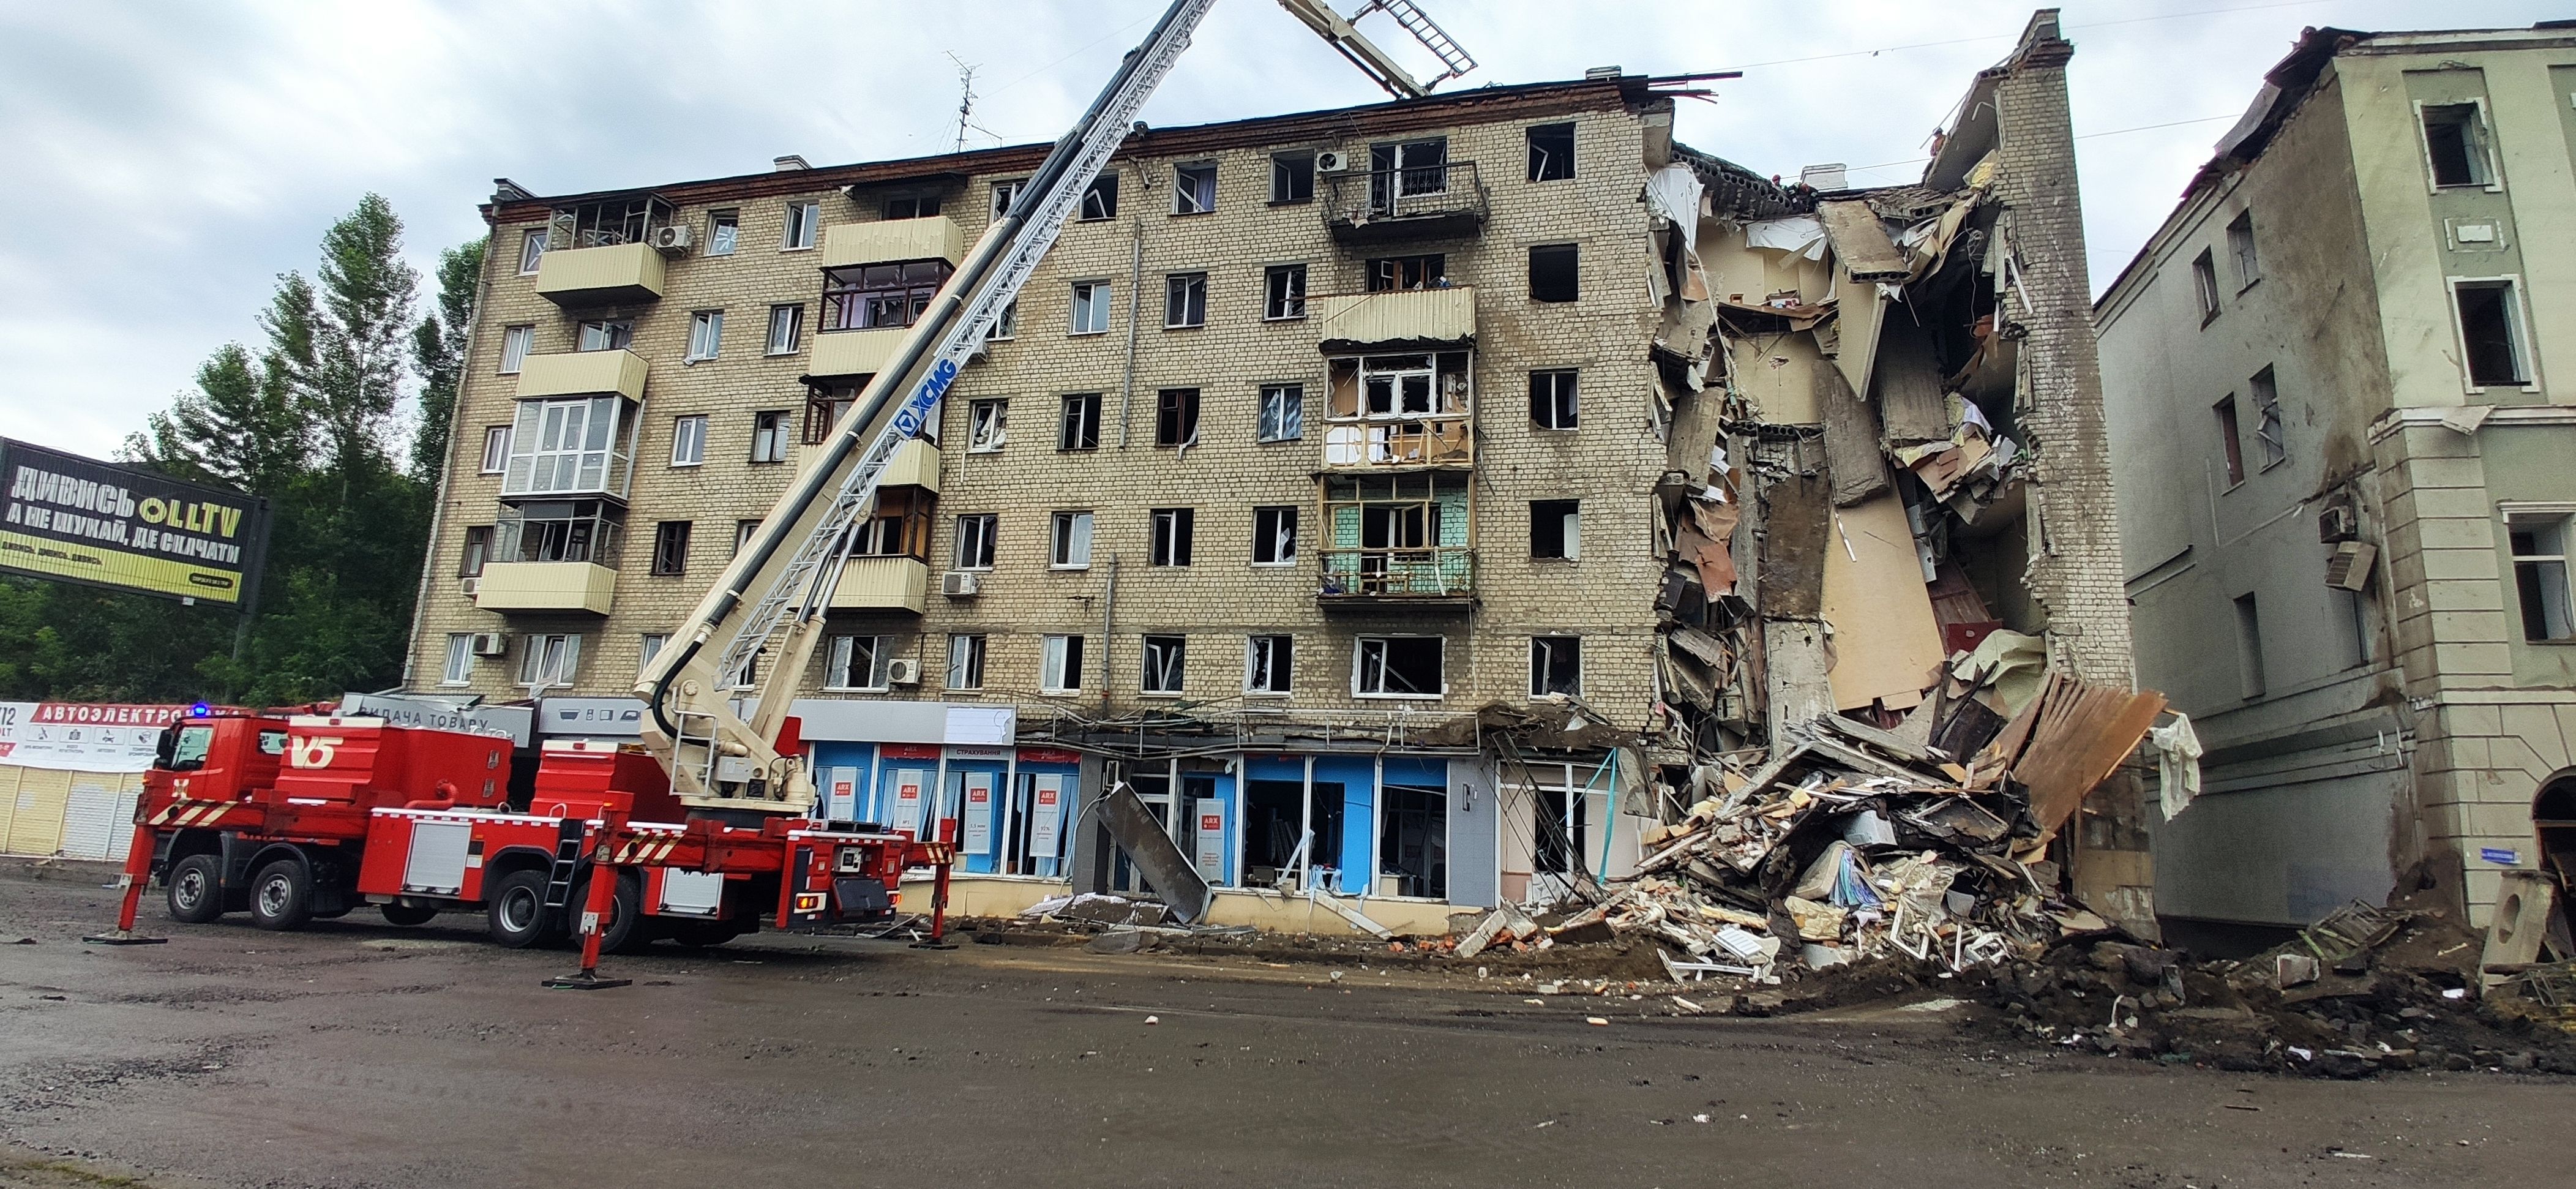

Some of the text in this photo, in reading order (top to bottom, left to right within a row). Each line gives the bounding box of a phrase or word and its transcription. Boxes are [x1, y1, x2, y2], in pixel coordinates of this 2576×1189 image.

[910, 359, 956, 421] XCMG
[11, 465, 135, 517] ДИВИСЬ
[6, 502, 241, 564] А НЕ ШУКАЙ, ДЕ СКАЧАТИ
[0, 707, 16, 725] 12
[430, 714, 488, 730] ТОВАРУ
[291, 735, 344, 770] V5
